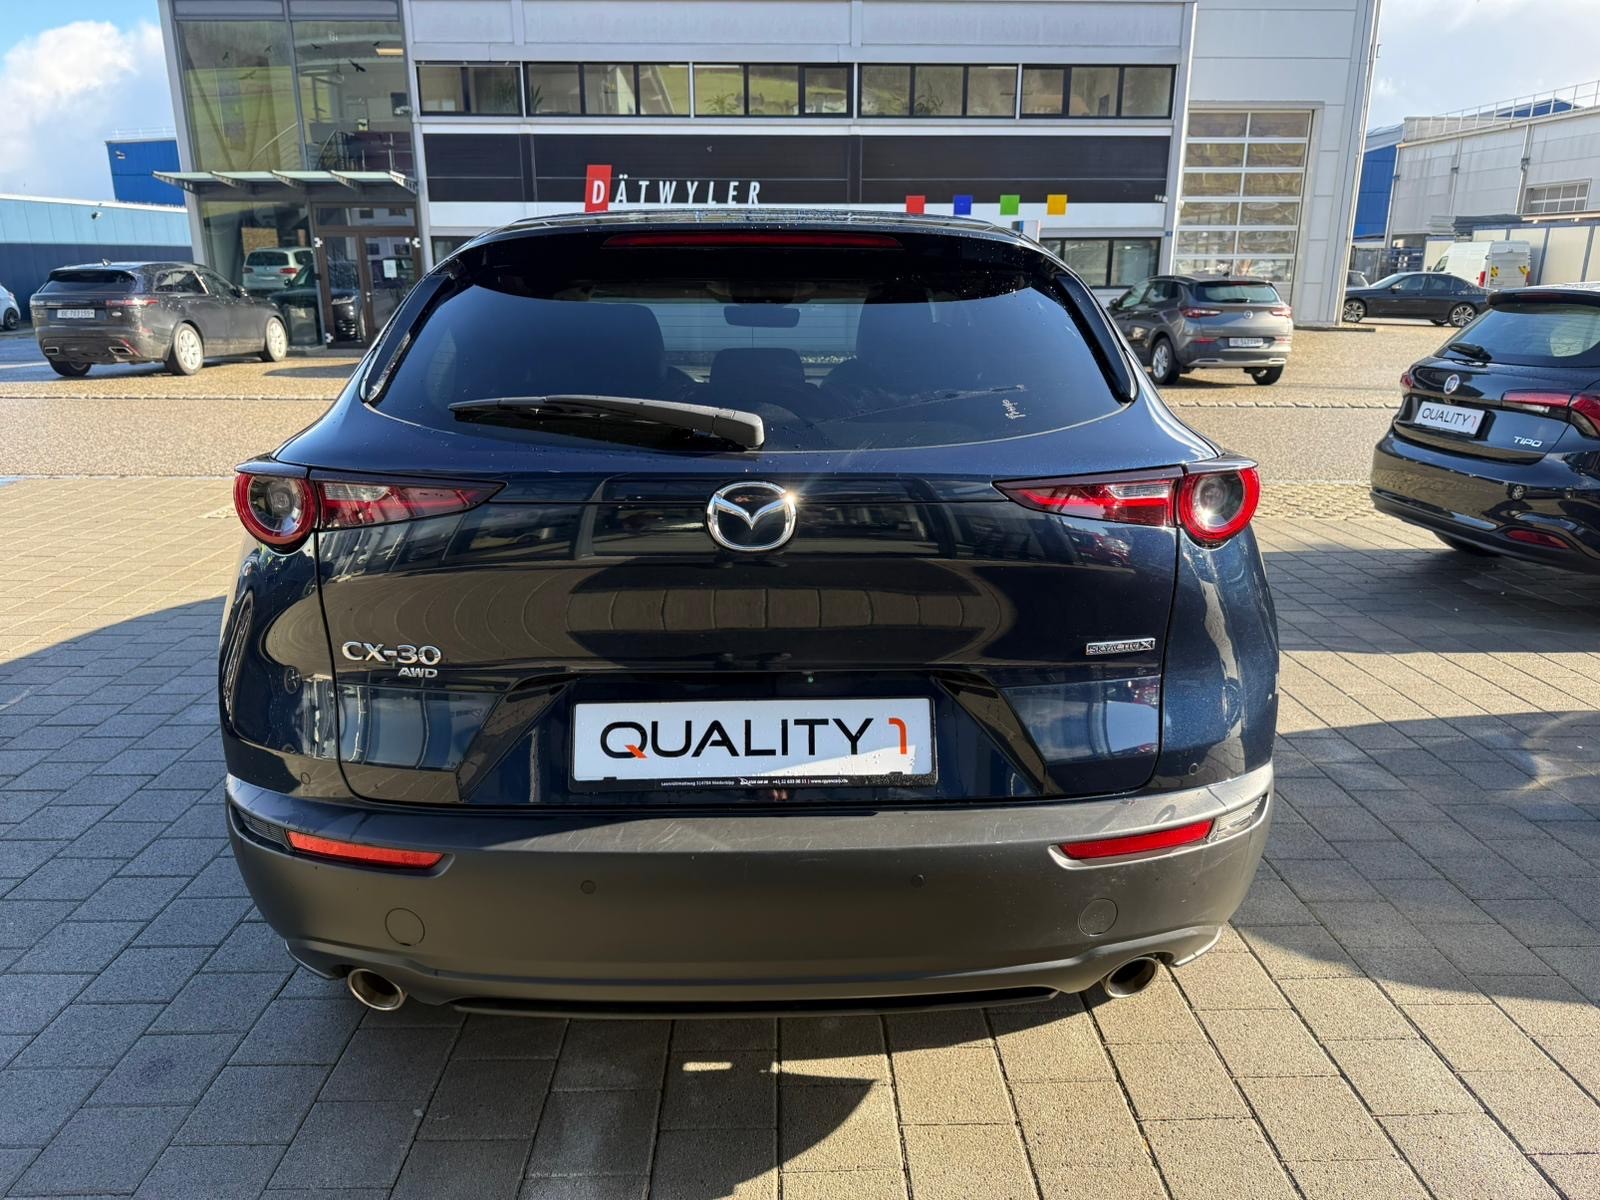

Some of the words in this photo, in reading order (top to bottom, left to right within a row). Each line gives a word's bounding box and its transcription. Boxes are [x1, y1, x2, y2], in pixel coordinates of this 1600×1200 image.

[591, 174, 761, 205] DÄTWYLER
[1422, 407, 1472, 427] QUALITY
[1513, 435, 1543, 448] TIPO
[342, 641, 441, 666] CX-30
[397, 667, 438, 678] AWD
[600, 717, 875, 758] QUALITY
[888, 717, 907, 755] 1
